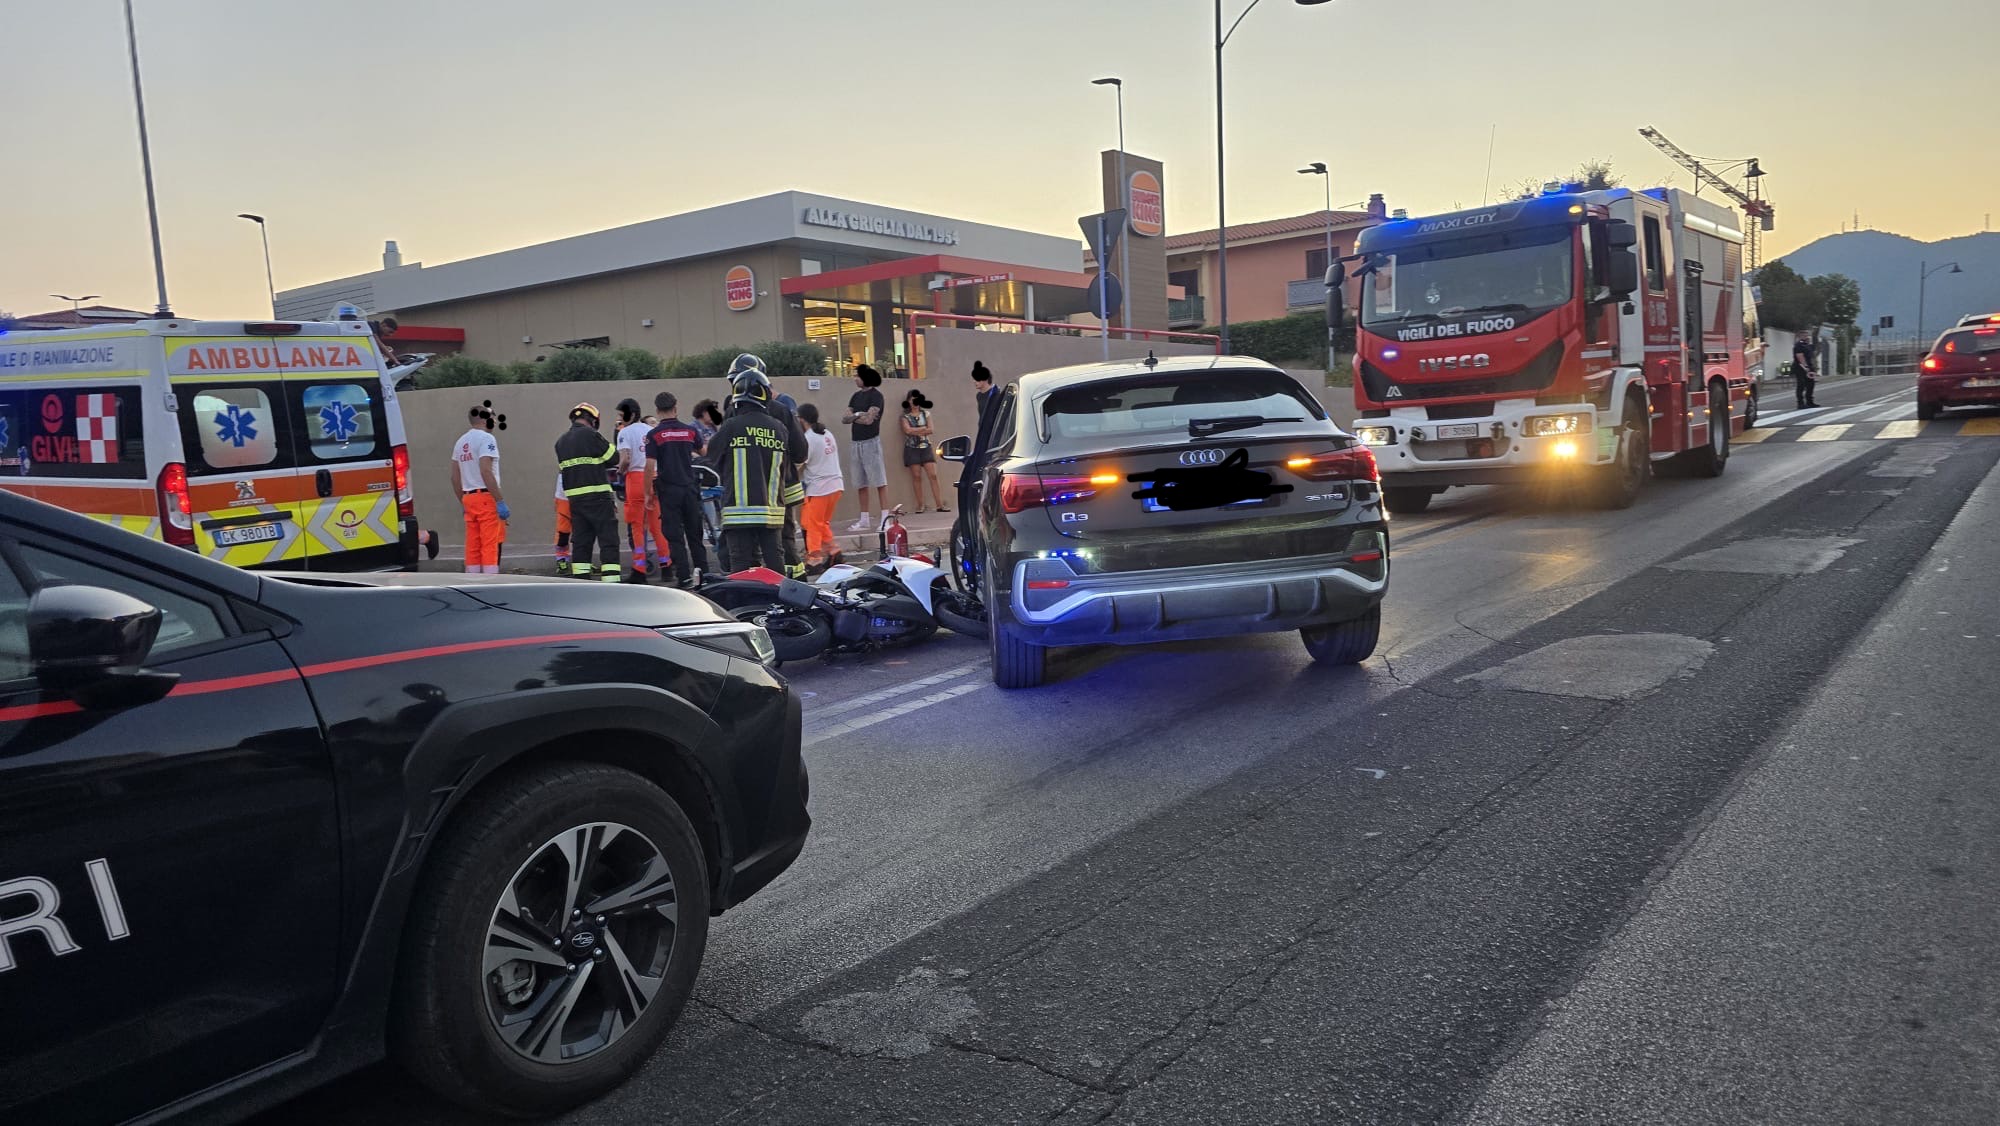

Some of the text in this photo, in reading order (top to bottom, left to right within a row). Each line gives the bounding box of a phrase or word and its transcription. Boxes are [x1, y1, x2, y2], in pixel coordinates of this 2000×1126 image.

[1132, 202, 1161, 223] KING
[1417, 212, 1497, 233] MAXI CITY
[804, 207, 848, 229] ALLA
[848, 214, 905, 236] GRIGLIA
[905, 222, 932, 241] DAL
[728, 287, 752, 301] KING
[1397, 317, 1515, 342] VIGILI DEL FUOCO
[33, 346, 114, 366] RIANIMAZIONE
[187, 346, 362, 370] AMBULANZA
[1419, 353, 1490, 373] IVECO
[745, 426, 776, 438] VIGILI
[1061, 512, 1089, 523] Q3
